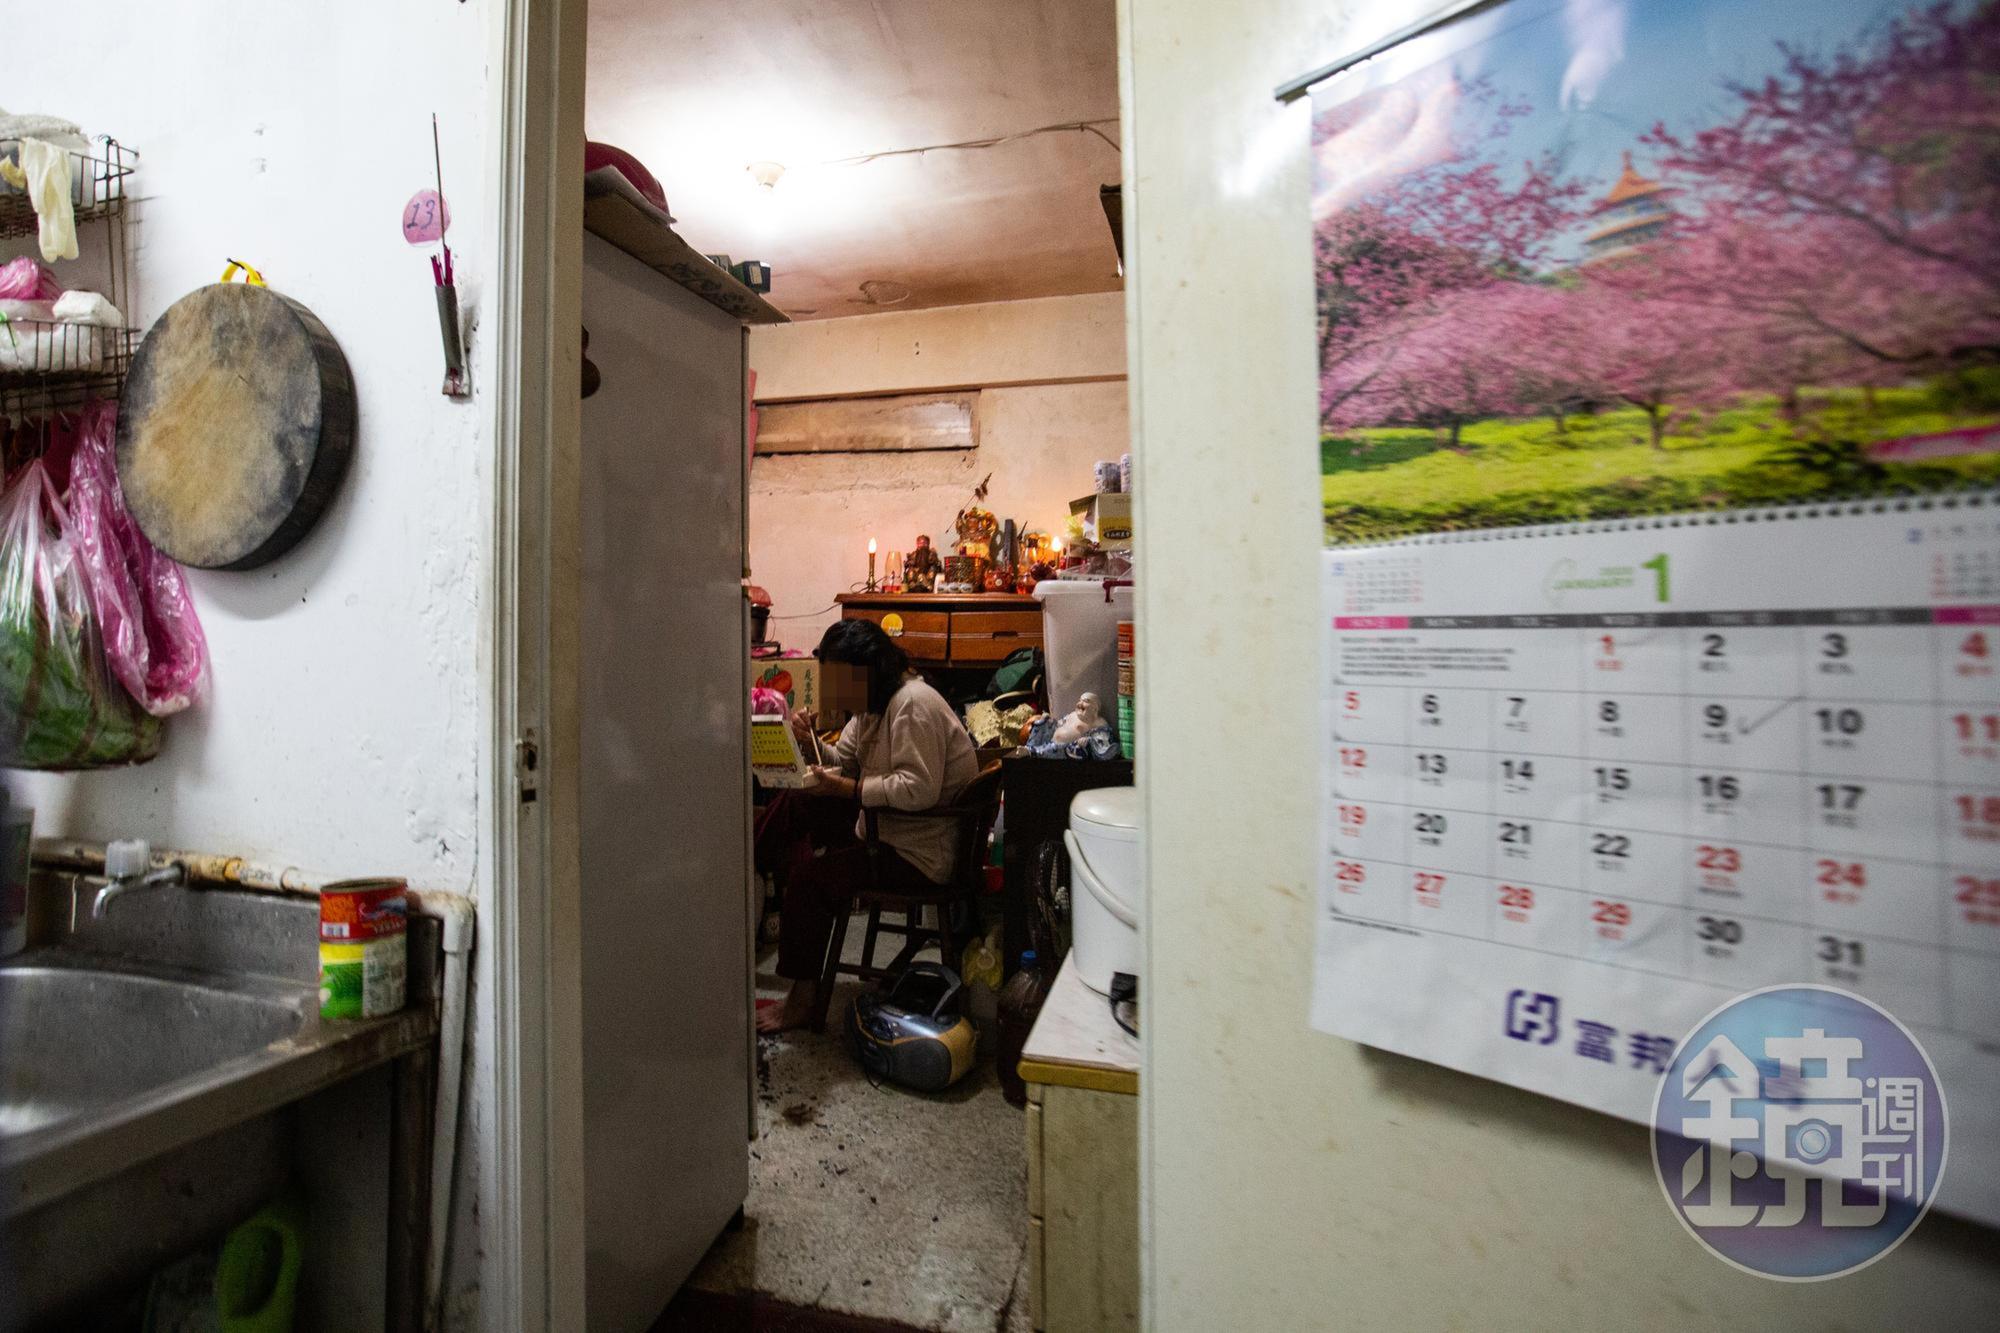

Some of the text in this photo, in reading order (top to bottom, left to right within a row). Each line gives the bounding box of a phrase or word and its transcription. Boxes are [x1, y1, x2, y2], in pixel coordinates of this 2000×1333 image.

[406, 199, 436, 230] 13
[1641, 553, 1670, 604] 1
[1703, 633, 1726, 657] 2
[1822, 632, 1849, 659] 3
[1960, 631, 1990, 659] 4
[1344, 690, 1360, 712] 5
[1421, 692, 1440, 715] 6
[1507, 695, 1527, 718] 7
[1600, 700, 1619, 723] 8
[1705, 704, 1728, 729] 9
[1815, 708, 1865, 736] 10
[1339, 748, 1366, 768] 12
[1417, 753, 1447, 775] 13
[1501, 760, 1534, 780] 14
[1594, 767, 1631, 792] 15
[1697, 775, 1740, 802] 16
[1817, 784, 1866, 810] 17
[1414, 812, 1446, 835] 20
[1499, 821, 1531, 844] 21
[1592, 832, 1630, 858] 22
[1697, 845, 1742, 873] 23
[1817, 859, 1867, 888] 24
[1413, 871, 1447, 894] 27
[1697, 916, 1743, 945] 30
[1818, 935, 1865, 967] 31
